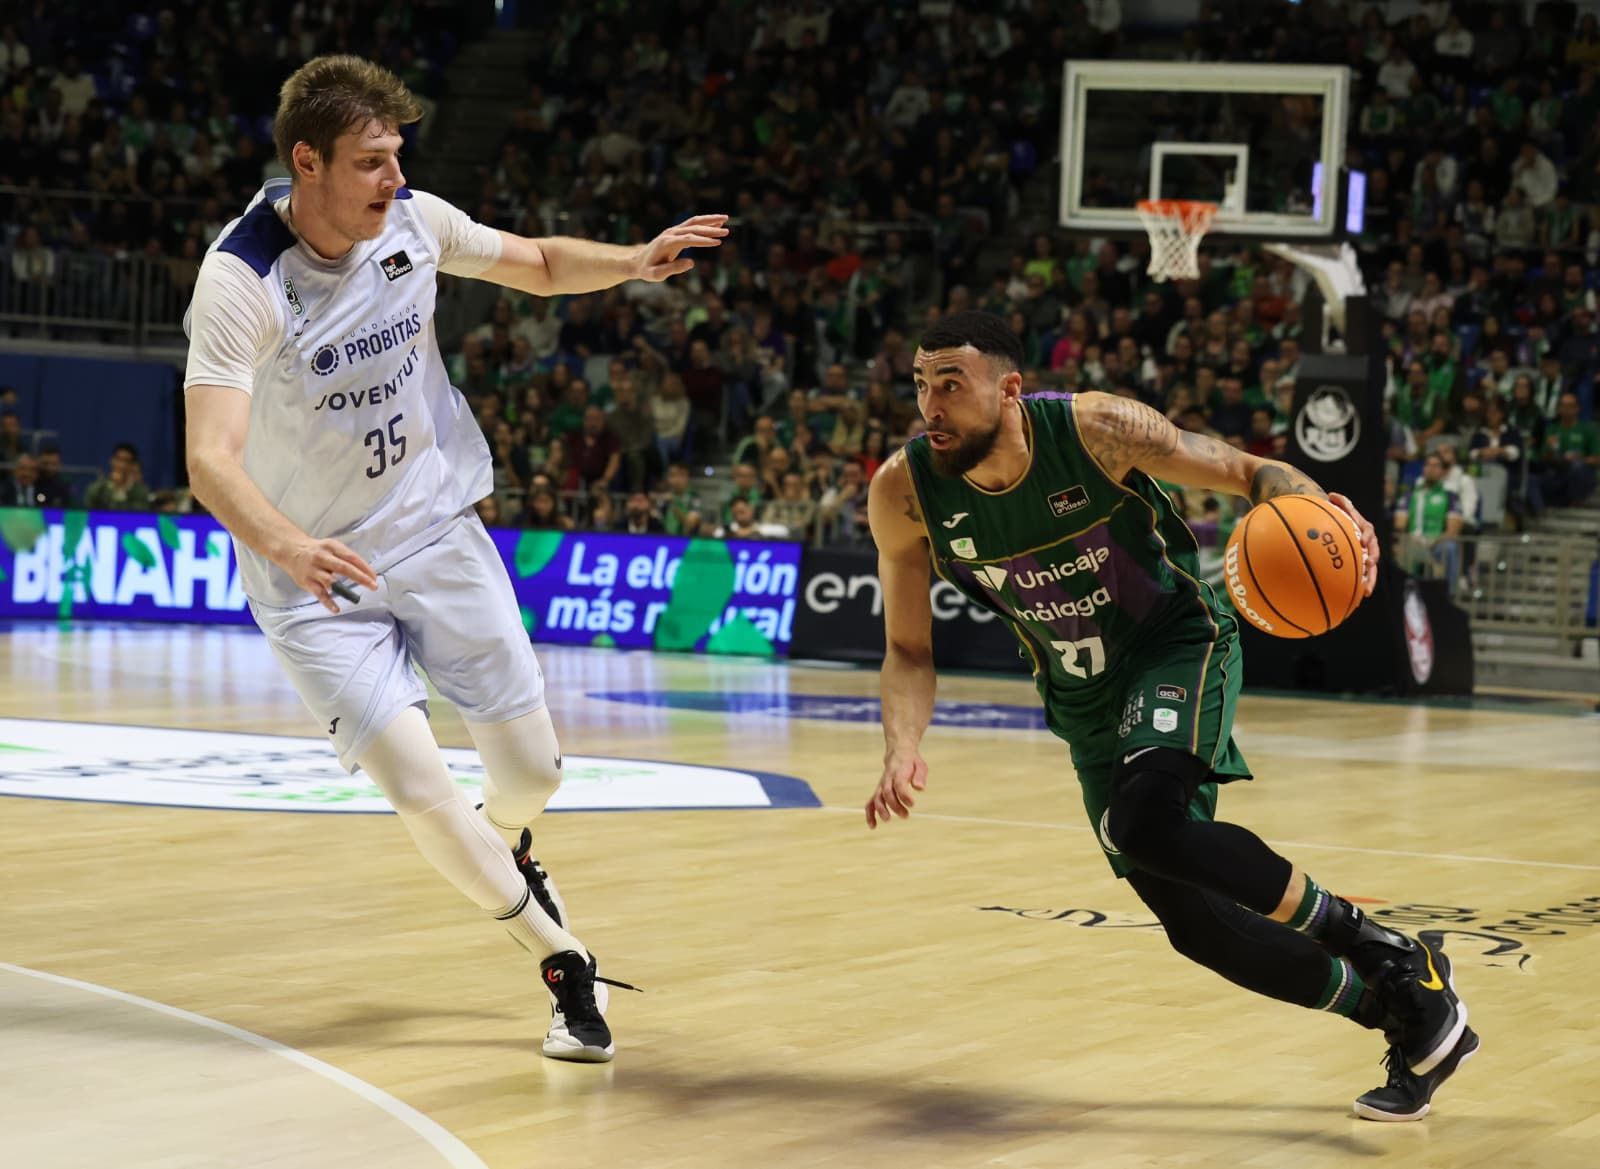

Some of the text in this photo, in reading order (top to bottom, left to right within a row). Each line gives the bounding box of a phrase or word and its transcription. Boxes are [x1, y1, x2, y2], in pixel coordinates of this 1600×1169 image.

[344, 313, 422, 365] PROBITAS
[314, 345, 419, 411] JOVENTUT
[364, 412, 407, 479] 35
[567, 542, 619, 587] La
[1014, 546, 1110, 589] Unicaja
[1322, 531, 1344, 570] acb
[546, 588, 636, 633] más
[1050, 636, 1106, 679] 27
